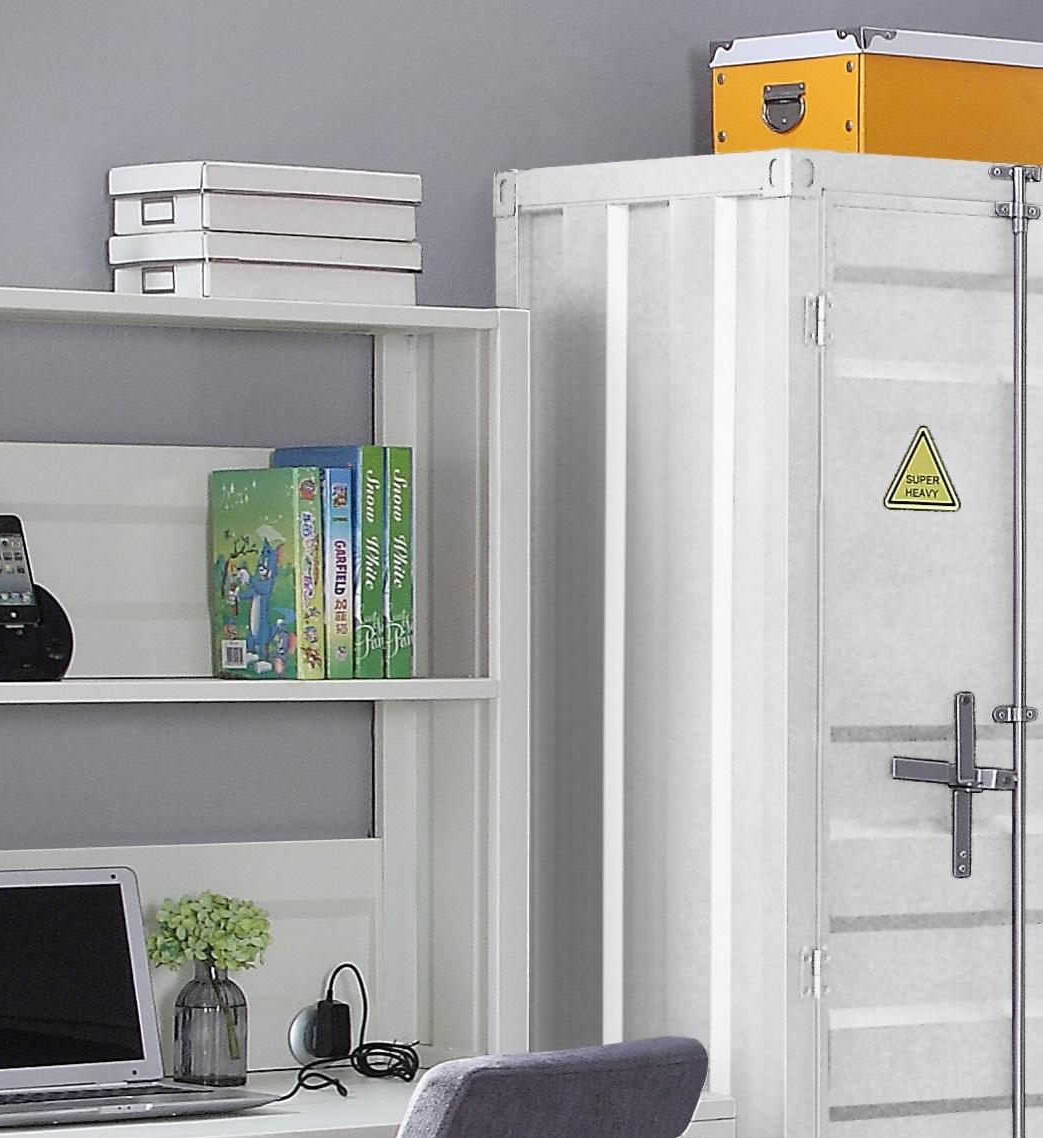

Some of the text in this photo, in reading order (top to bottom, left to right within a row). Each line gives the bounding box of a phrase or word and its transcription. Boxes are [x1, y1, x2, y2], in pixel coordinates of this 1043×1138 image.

[905, 475, 940, 485] SUPER
[905, 488, 939, 499] HEAVY
[365, 469, 380, 591] Snow White
[393, 468, 408, 590] Snow White
[333, 540, 348, 595] GARFIELD
